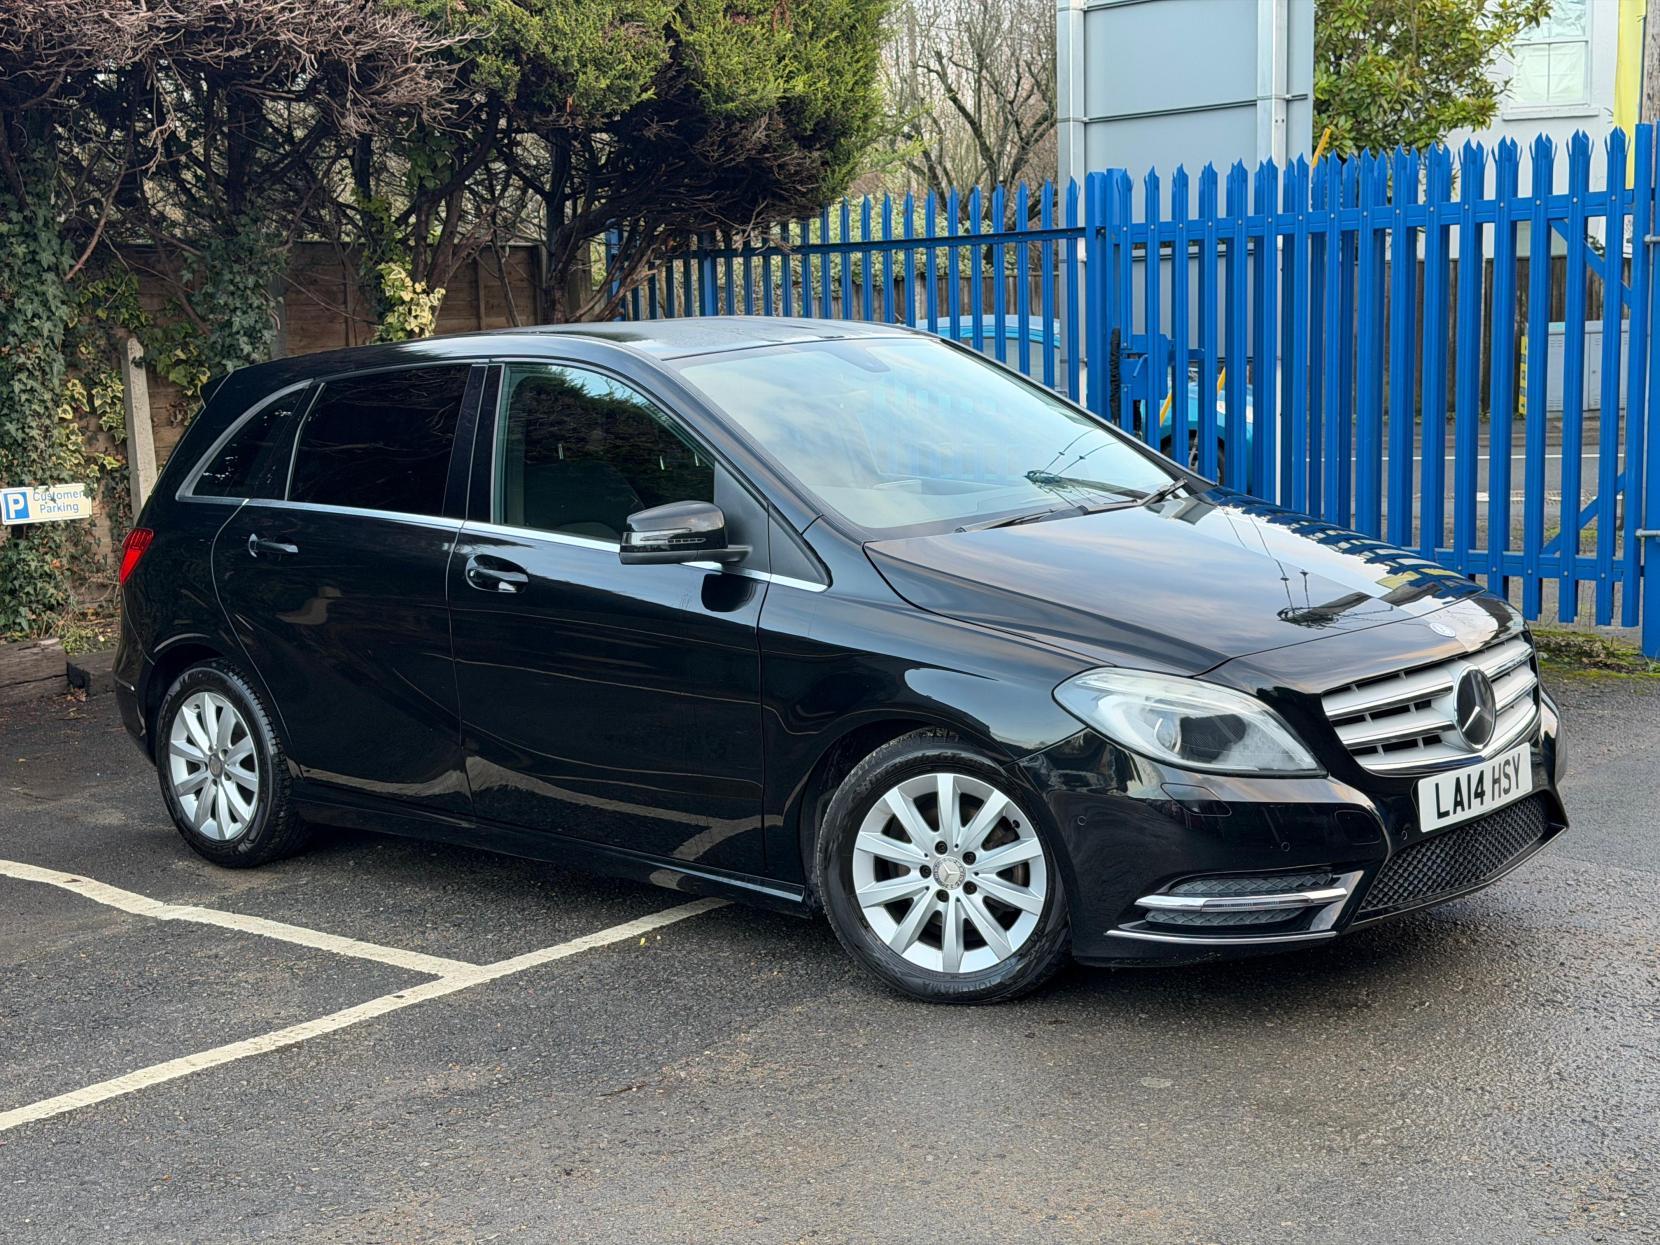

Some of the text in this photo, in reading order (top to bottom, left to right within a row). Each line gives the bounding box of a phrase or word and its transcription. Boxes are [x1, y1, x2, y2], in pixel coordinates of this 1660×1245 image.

[33, 490, 82, 502] Customer
[7, 493, 25, 518] P
[40, 502, 79, 513] Parking
[1435, 753, 1521, 820] LA14 HSY
